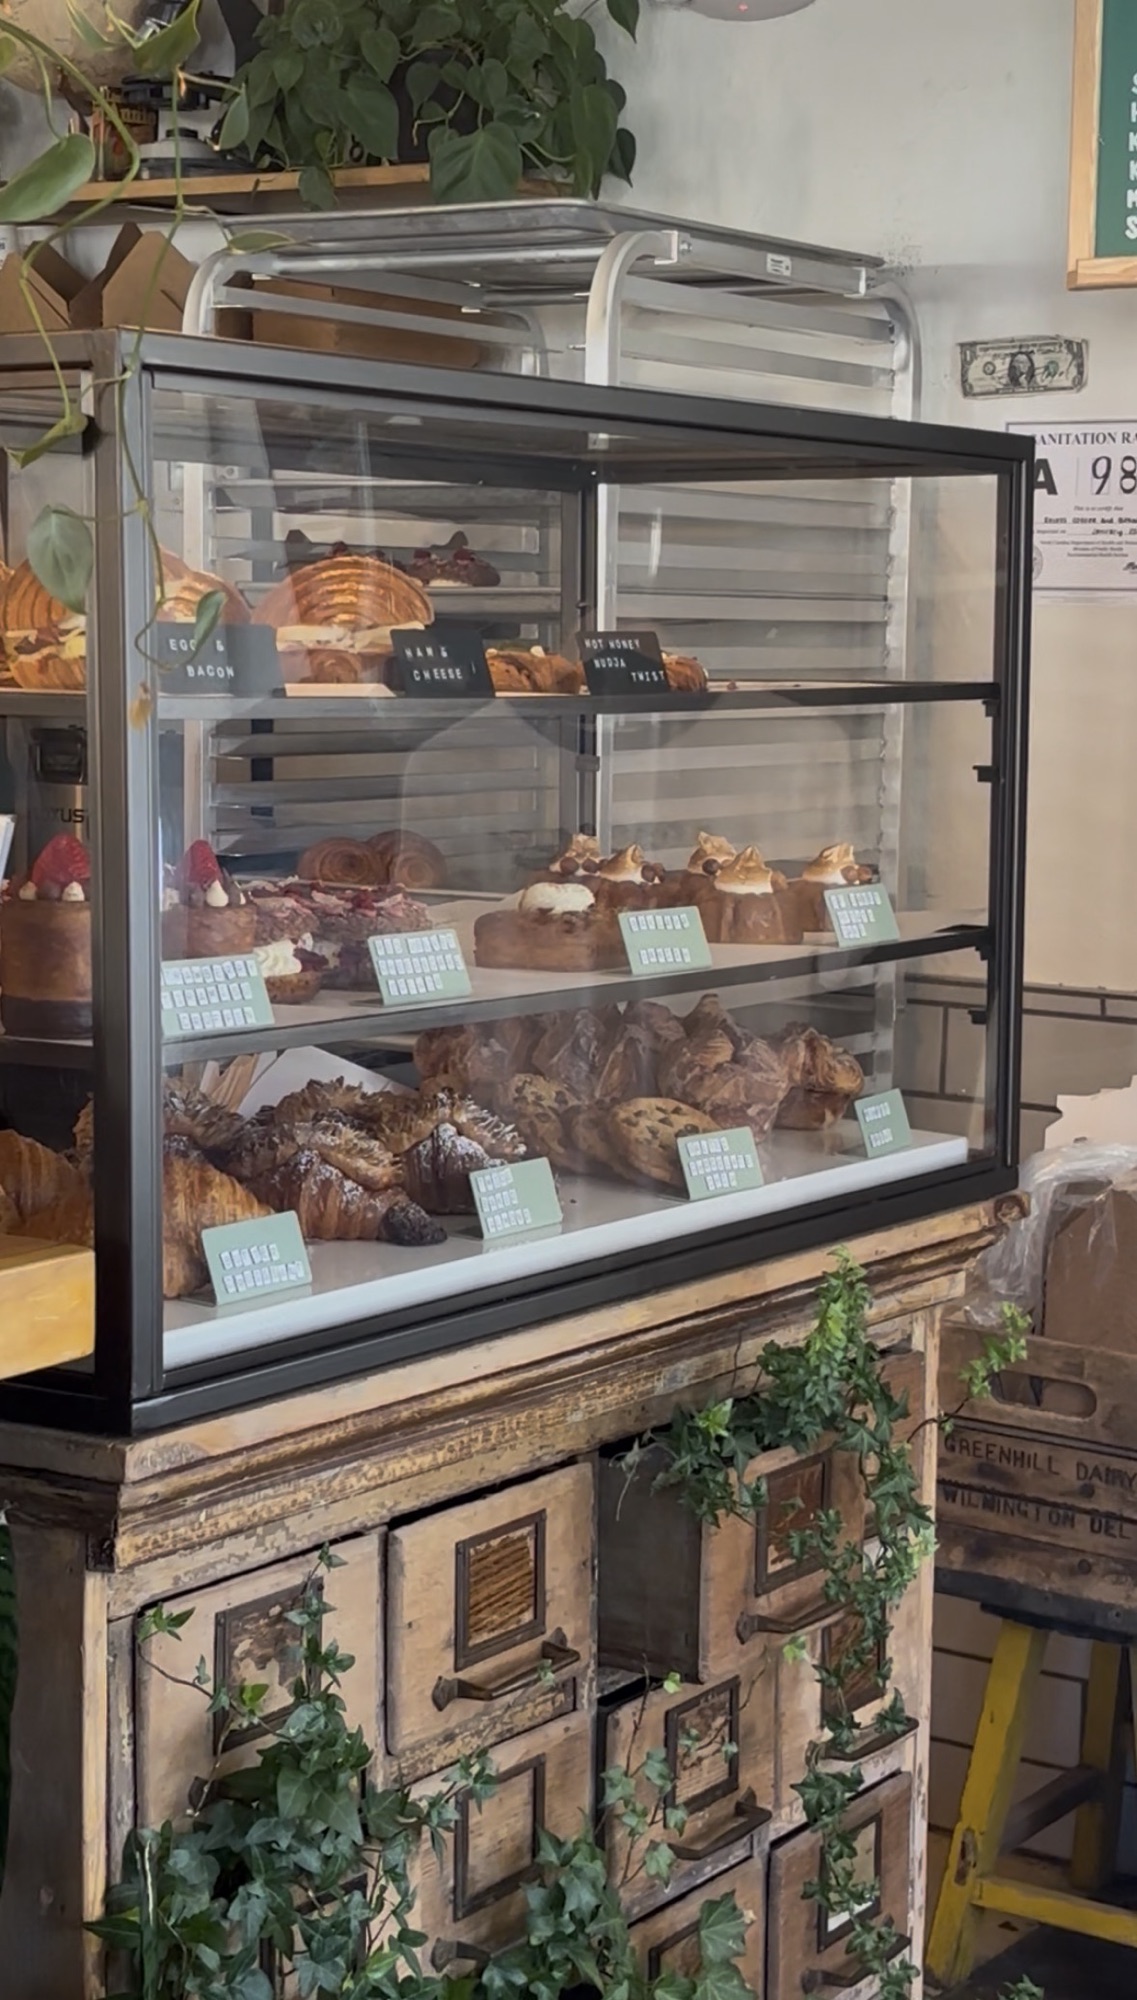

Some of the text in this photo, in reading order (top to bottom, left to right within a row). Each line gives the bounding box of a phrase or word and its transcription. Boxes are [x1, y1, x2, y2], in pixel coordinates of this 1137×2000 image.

[1036, 431, 1117, 446] ANITATION
[584, 638, 640, 650] HOT HONEY
[404, 646, 434, 658] HAM
[186, 665, 235, 678] BACON
[413, 668, 462, 681] CHEESE
[631, 670, 665, 682] TWIST
[944, 1436, 1137, 1491] GREENHILL DAIRY
[943, 1486, 1132, 1540] WILMINGTON DEL
